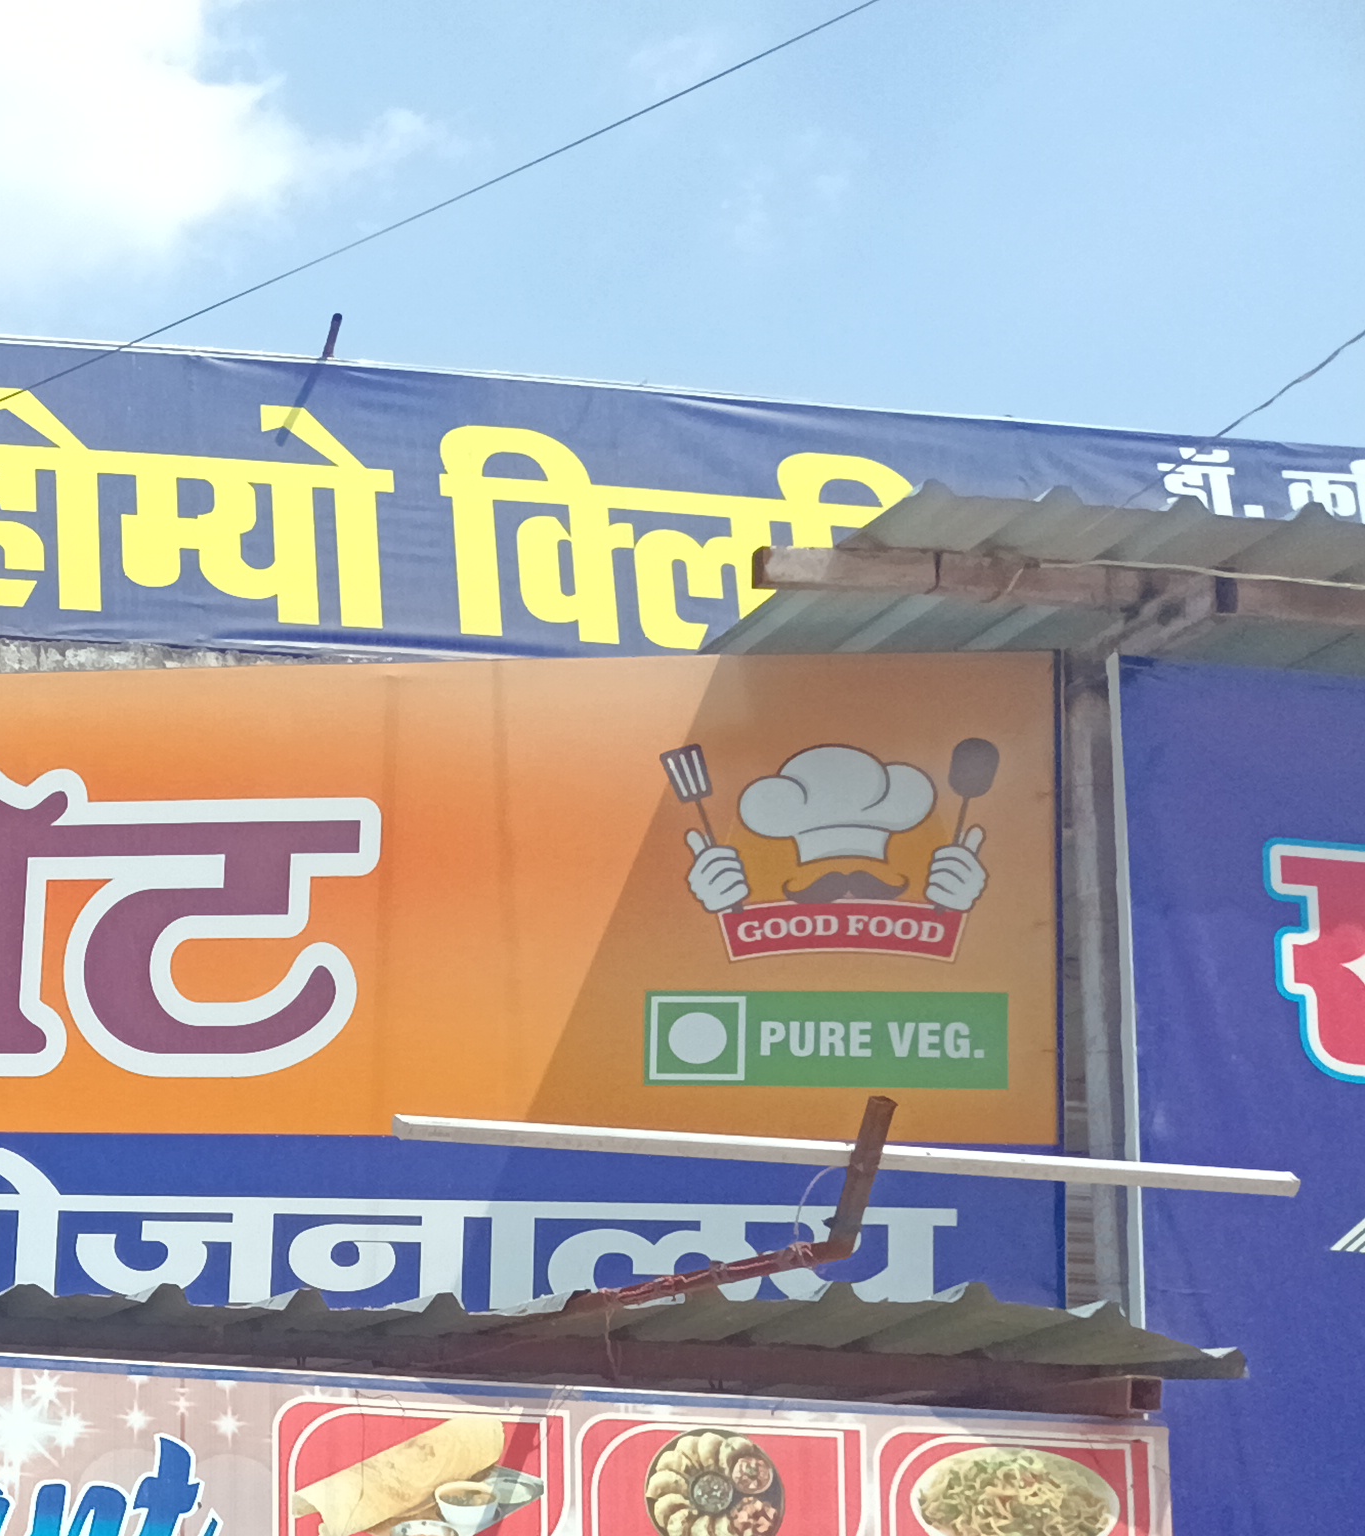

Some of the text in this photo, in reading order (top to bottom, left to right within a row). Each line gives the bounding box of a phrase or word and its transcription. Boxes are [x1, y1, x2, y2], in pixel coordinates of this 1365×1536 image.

[737, 914, 945, 943] GOOD FOOD
[760, 1021, 985, 1059] PURE VEG.
